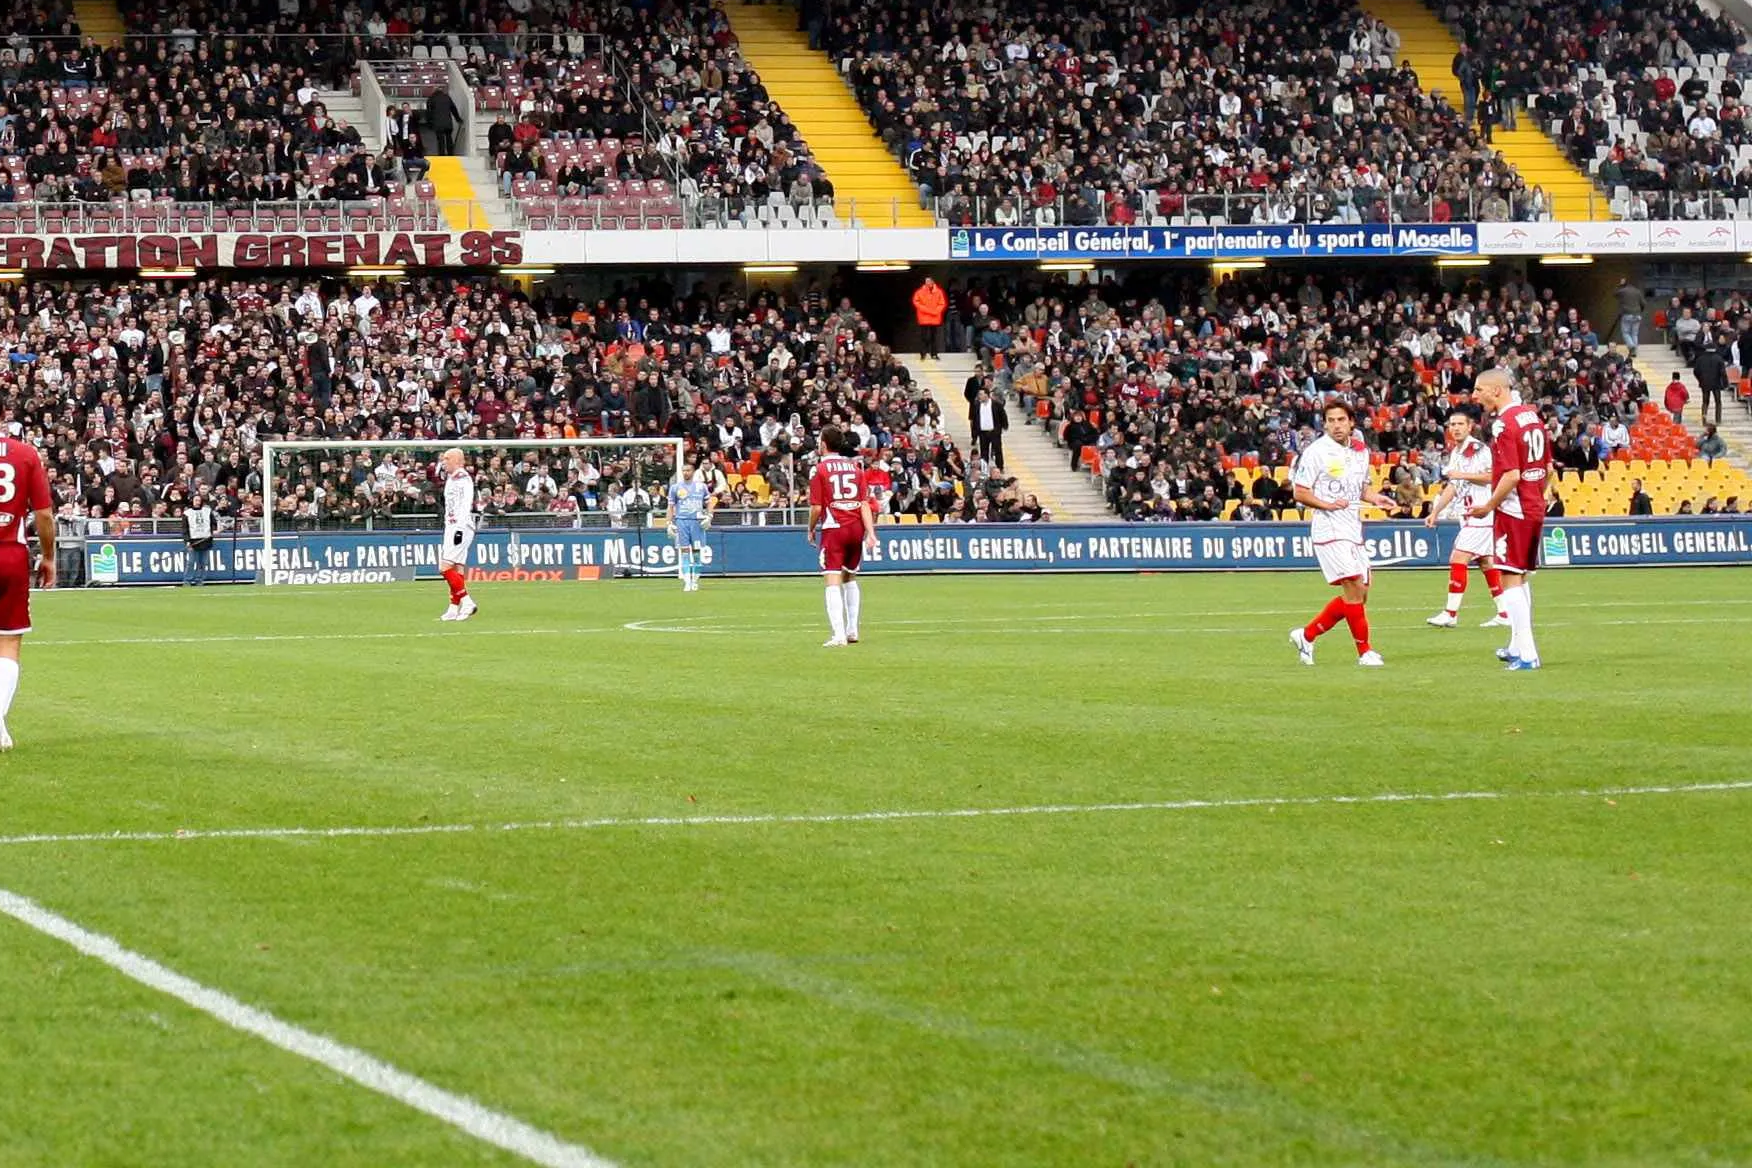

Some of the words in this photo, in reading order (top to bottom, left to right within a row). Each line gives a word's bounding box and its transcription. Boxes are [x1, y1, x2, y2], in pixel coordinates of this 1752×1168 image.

[234, 233, 451, 267] GRENAT
[460, 230, 523, 266] 95
[975, 233, 996, 252] Le
[1002, 232, 1071, 252] Conseil
[1075, 230, 1154, 254] Général,
[1163, 232, 1179, 252] 1er
[1185, 232, 1281, 256] partenaire
[1287, 232, 1312, 250] du
[1317, 232, 1366, 254] sport
[1370, 233, 1394, 249] en
[1398, 228, 1473, 248] Moselle
[1523, 429, 1545, 463] 10
[829, 474, 859, 500] 15
[122, 551, 142, 573] LE
[150, 549, 225, 572] CONIL
[325, 546, 349, 567] 1er
[478, 543, 499, 564] DU
[507, 543, 564, 565] SPORT
[572, 543, 593, 564] EN
[604, 538, 713, 565] Mosee
[863, 540, 882, 561] LE
[888, 538, 962, 560] CONSEIL
[969, 538, 1054, 563] GENERAL,
[1058, 538, 1082, 559] 1er
[1089, 537, 1192, 558] PARTENAIRE
[1204, 537, 1223, 558] DU
[1232, 537, 1285, 558] SPORT
[1293, 536, 1313, 558] EN
[1366, 530, 1428, 559] selle
[1571, 535, 1591, 556] LE
[1598, 533, 1667, 555] CONSEIL
[467, 568, 564, 582] livebox
